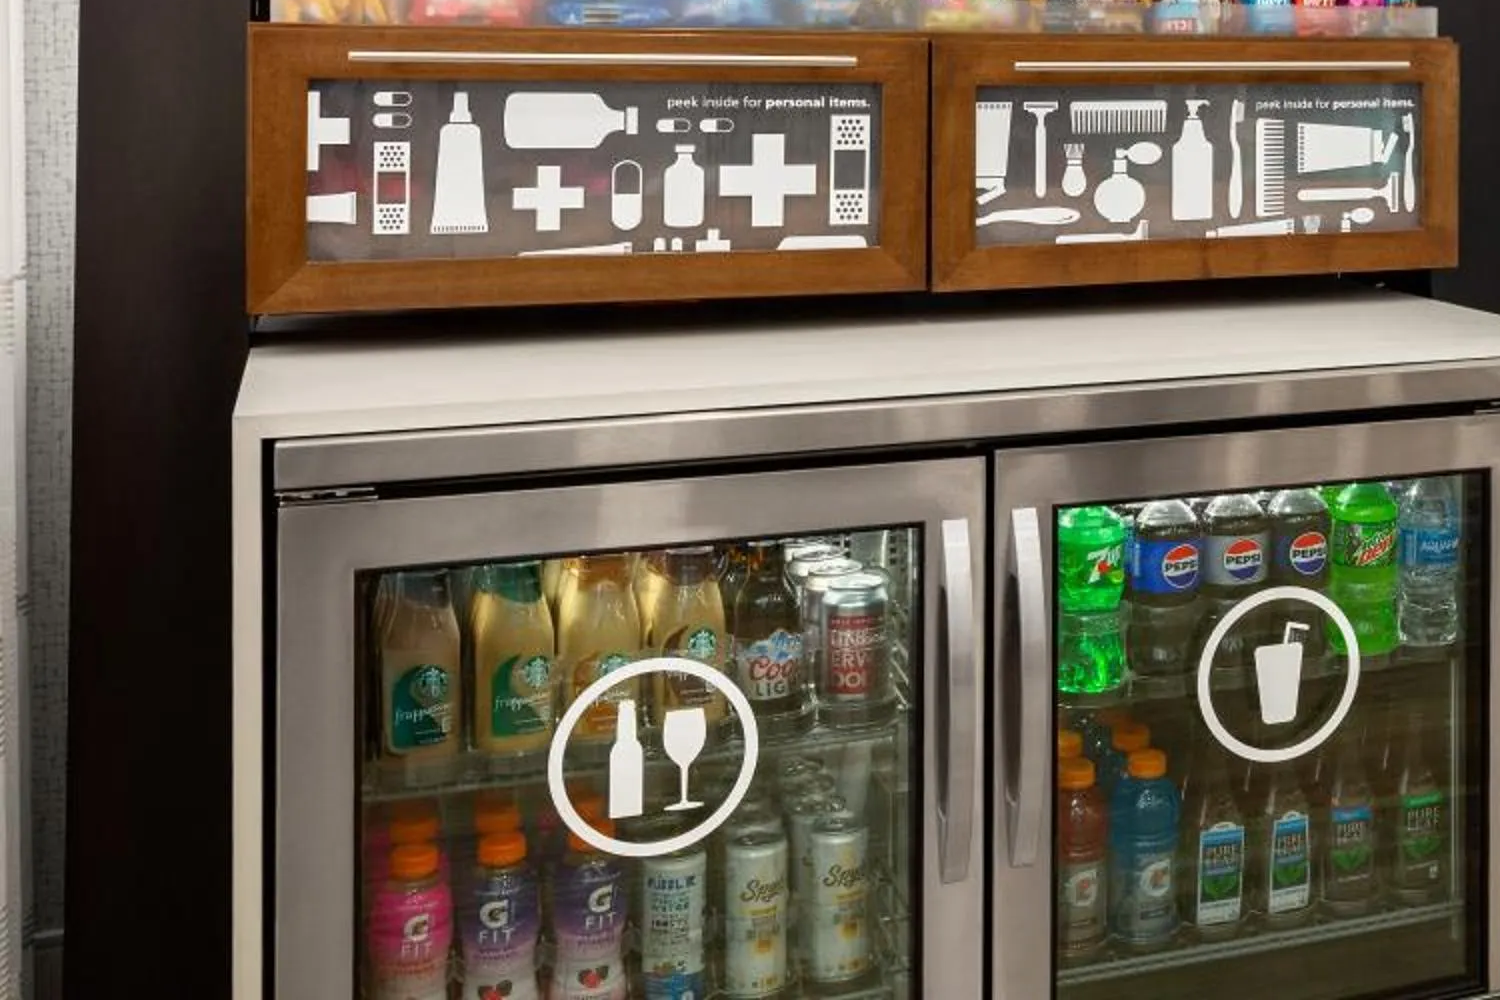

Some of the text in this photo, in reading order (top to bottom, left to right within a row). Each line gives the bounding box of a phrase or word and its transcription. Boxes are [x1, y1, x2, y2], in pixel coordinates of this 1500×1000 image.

[667, 96, 698, 110] peek
[743, 96, 762, 108] for
[765, 96, 825, 110] personal
[1315, 98, 1330, 109] for
[1332, 97, 1380, 111] personal
[1225, 552, 1261, 566] PEPSI
[585, 912, 616, 931] FIT
[478, 928, 516, 945] FIT
